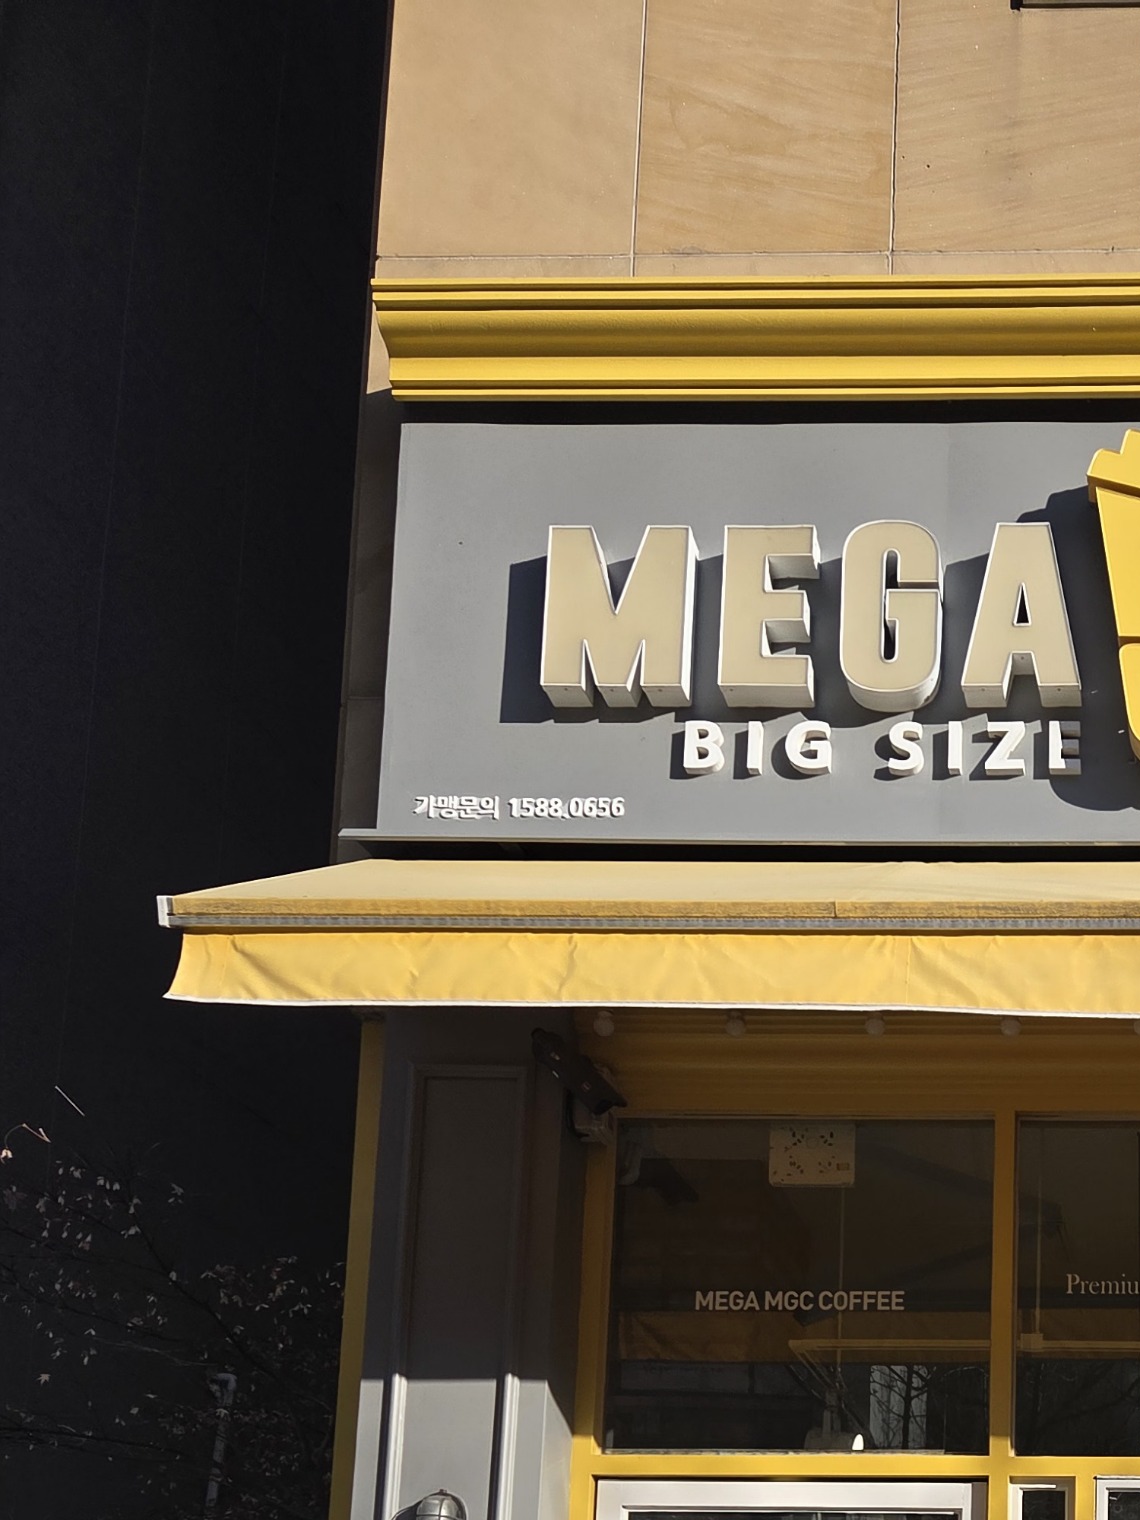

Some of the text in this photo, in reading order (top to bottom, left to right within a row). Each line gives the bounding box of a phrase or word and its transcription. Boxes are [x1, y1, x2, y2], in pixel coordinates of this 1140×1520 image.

[540, 520, 1083, 710] MEGA
[682, 720, 833, 776] BIG
[886, 720, 1082, 776] SIZE
[413, 795, 500, 820] 가맹문의
[695, 1290, 905, 1312] MEGA MGC COFFEE
